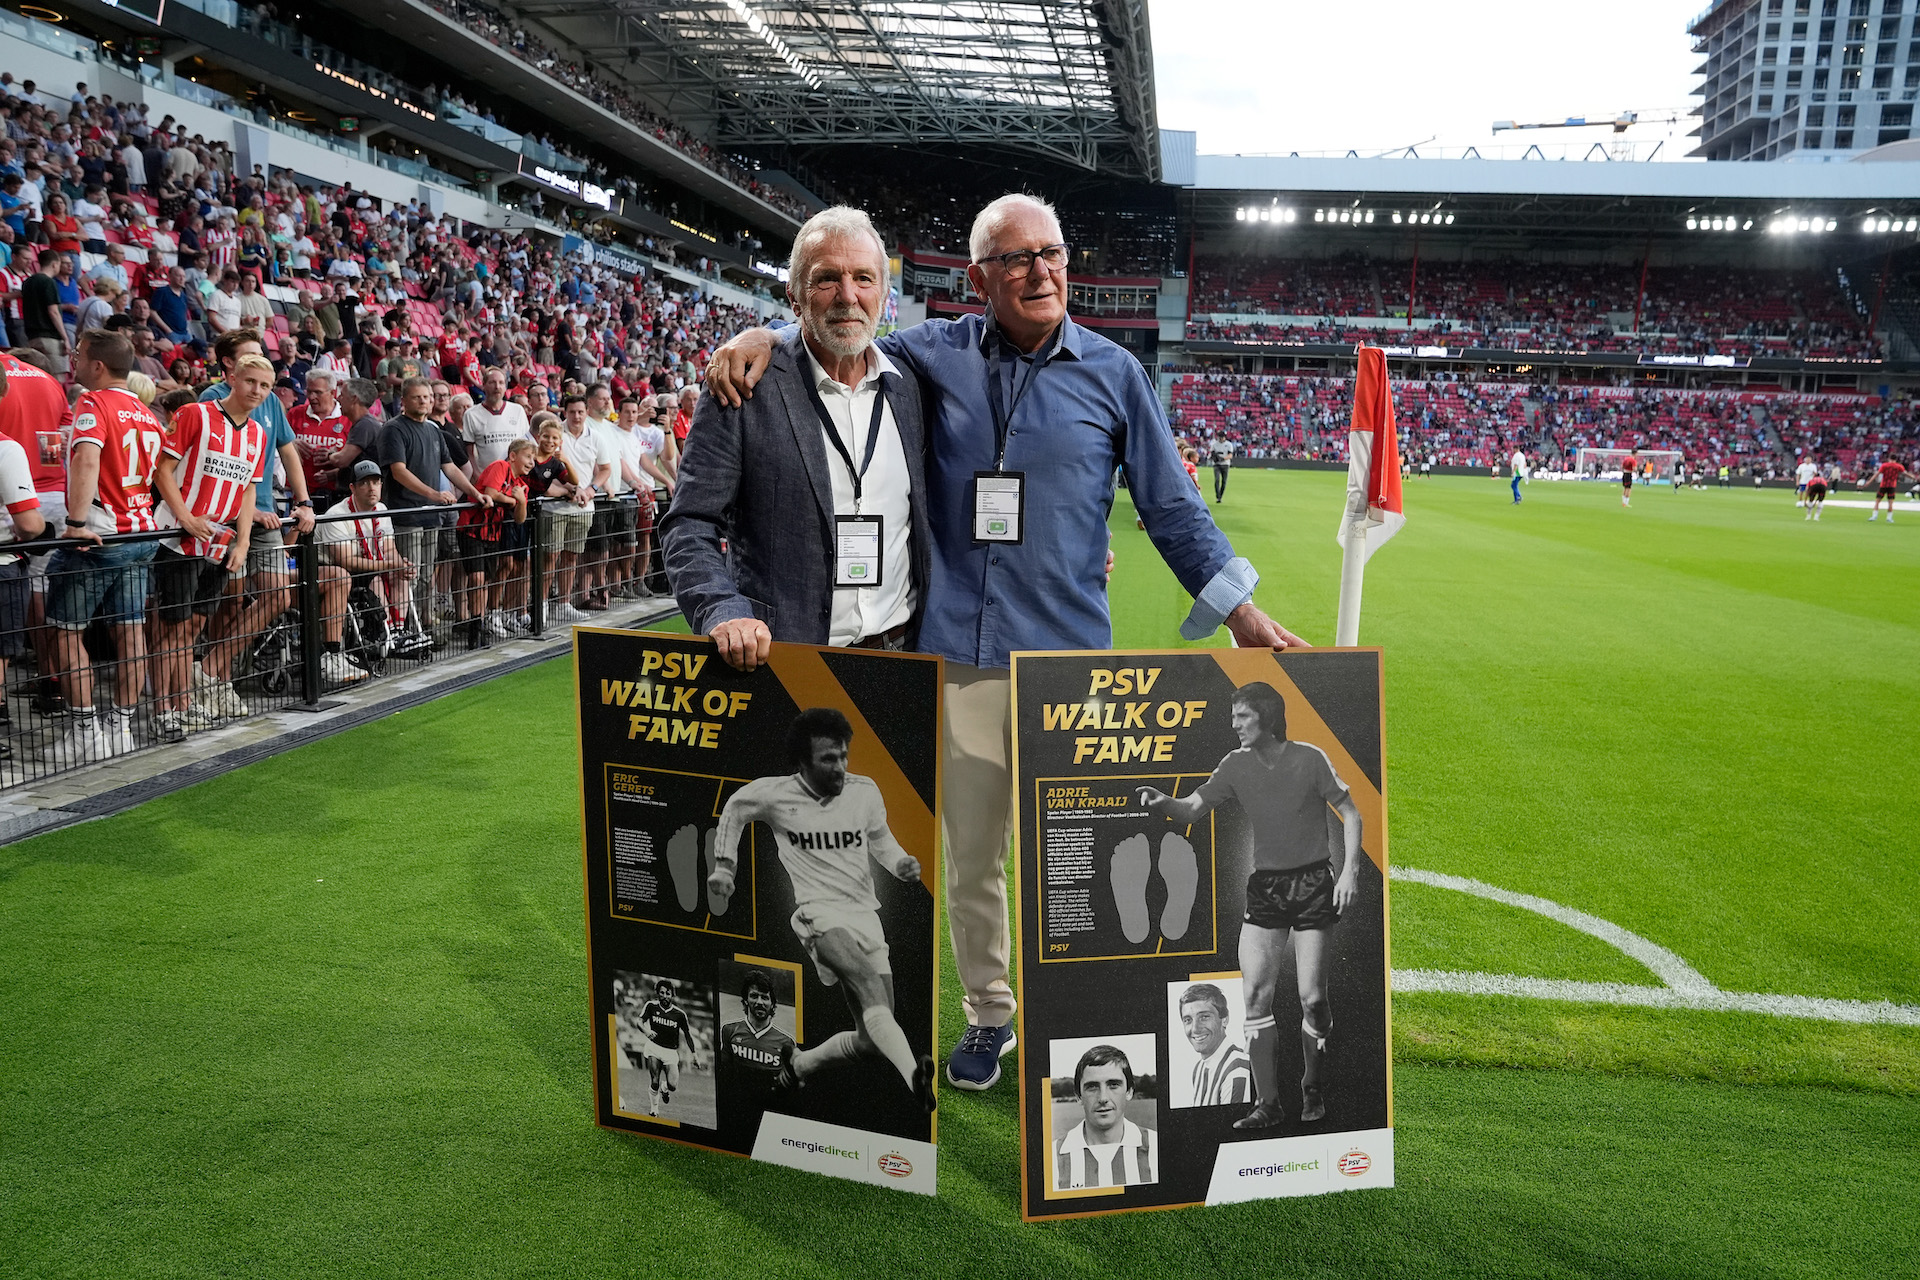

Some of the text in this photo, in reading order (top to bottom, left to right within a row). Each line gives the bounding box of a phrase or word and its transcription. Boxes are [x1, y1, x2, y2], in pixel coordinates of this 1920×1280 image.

[596, 248, 646, 277] philips stadion
[296, 434, 344, 448] PHILIPS
[121, 428, 161, 488] 17
[205, 456, 252, 476] BRAINPOT
[204, 465, 248, 482] EINDHOV
[640, 650, 708, 680] PSV
[1088, 668, 1162, 696] PSV
[600, 678, 752, 718] WALK OF
[1042, 701, 1208, 732] WALK OF
[628, 714, 722, 749] FAME
[1072, 735, 1177, 765] FAME
[613, 772, 640, 784] ERIC
[613, 782, 655, 795] GERETS
[1046, 787, 1090, 798] ADRIE
[1047, 796, 1128, 808] VAN KRAAIJ
[787, 829, 862, 851] PHILIPS
[618, 904, 634, 912] PSV
[1050, 944, 1070, 952] PSV
[652, 1016, 678, 1028] PHILIPS
[731, 1043, 780, 1066] PHILIPS
[781, 1138, 860, 1160] energiedirect
[1238, 1160, 1320, 1176] energiedirect
